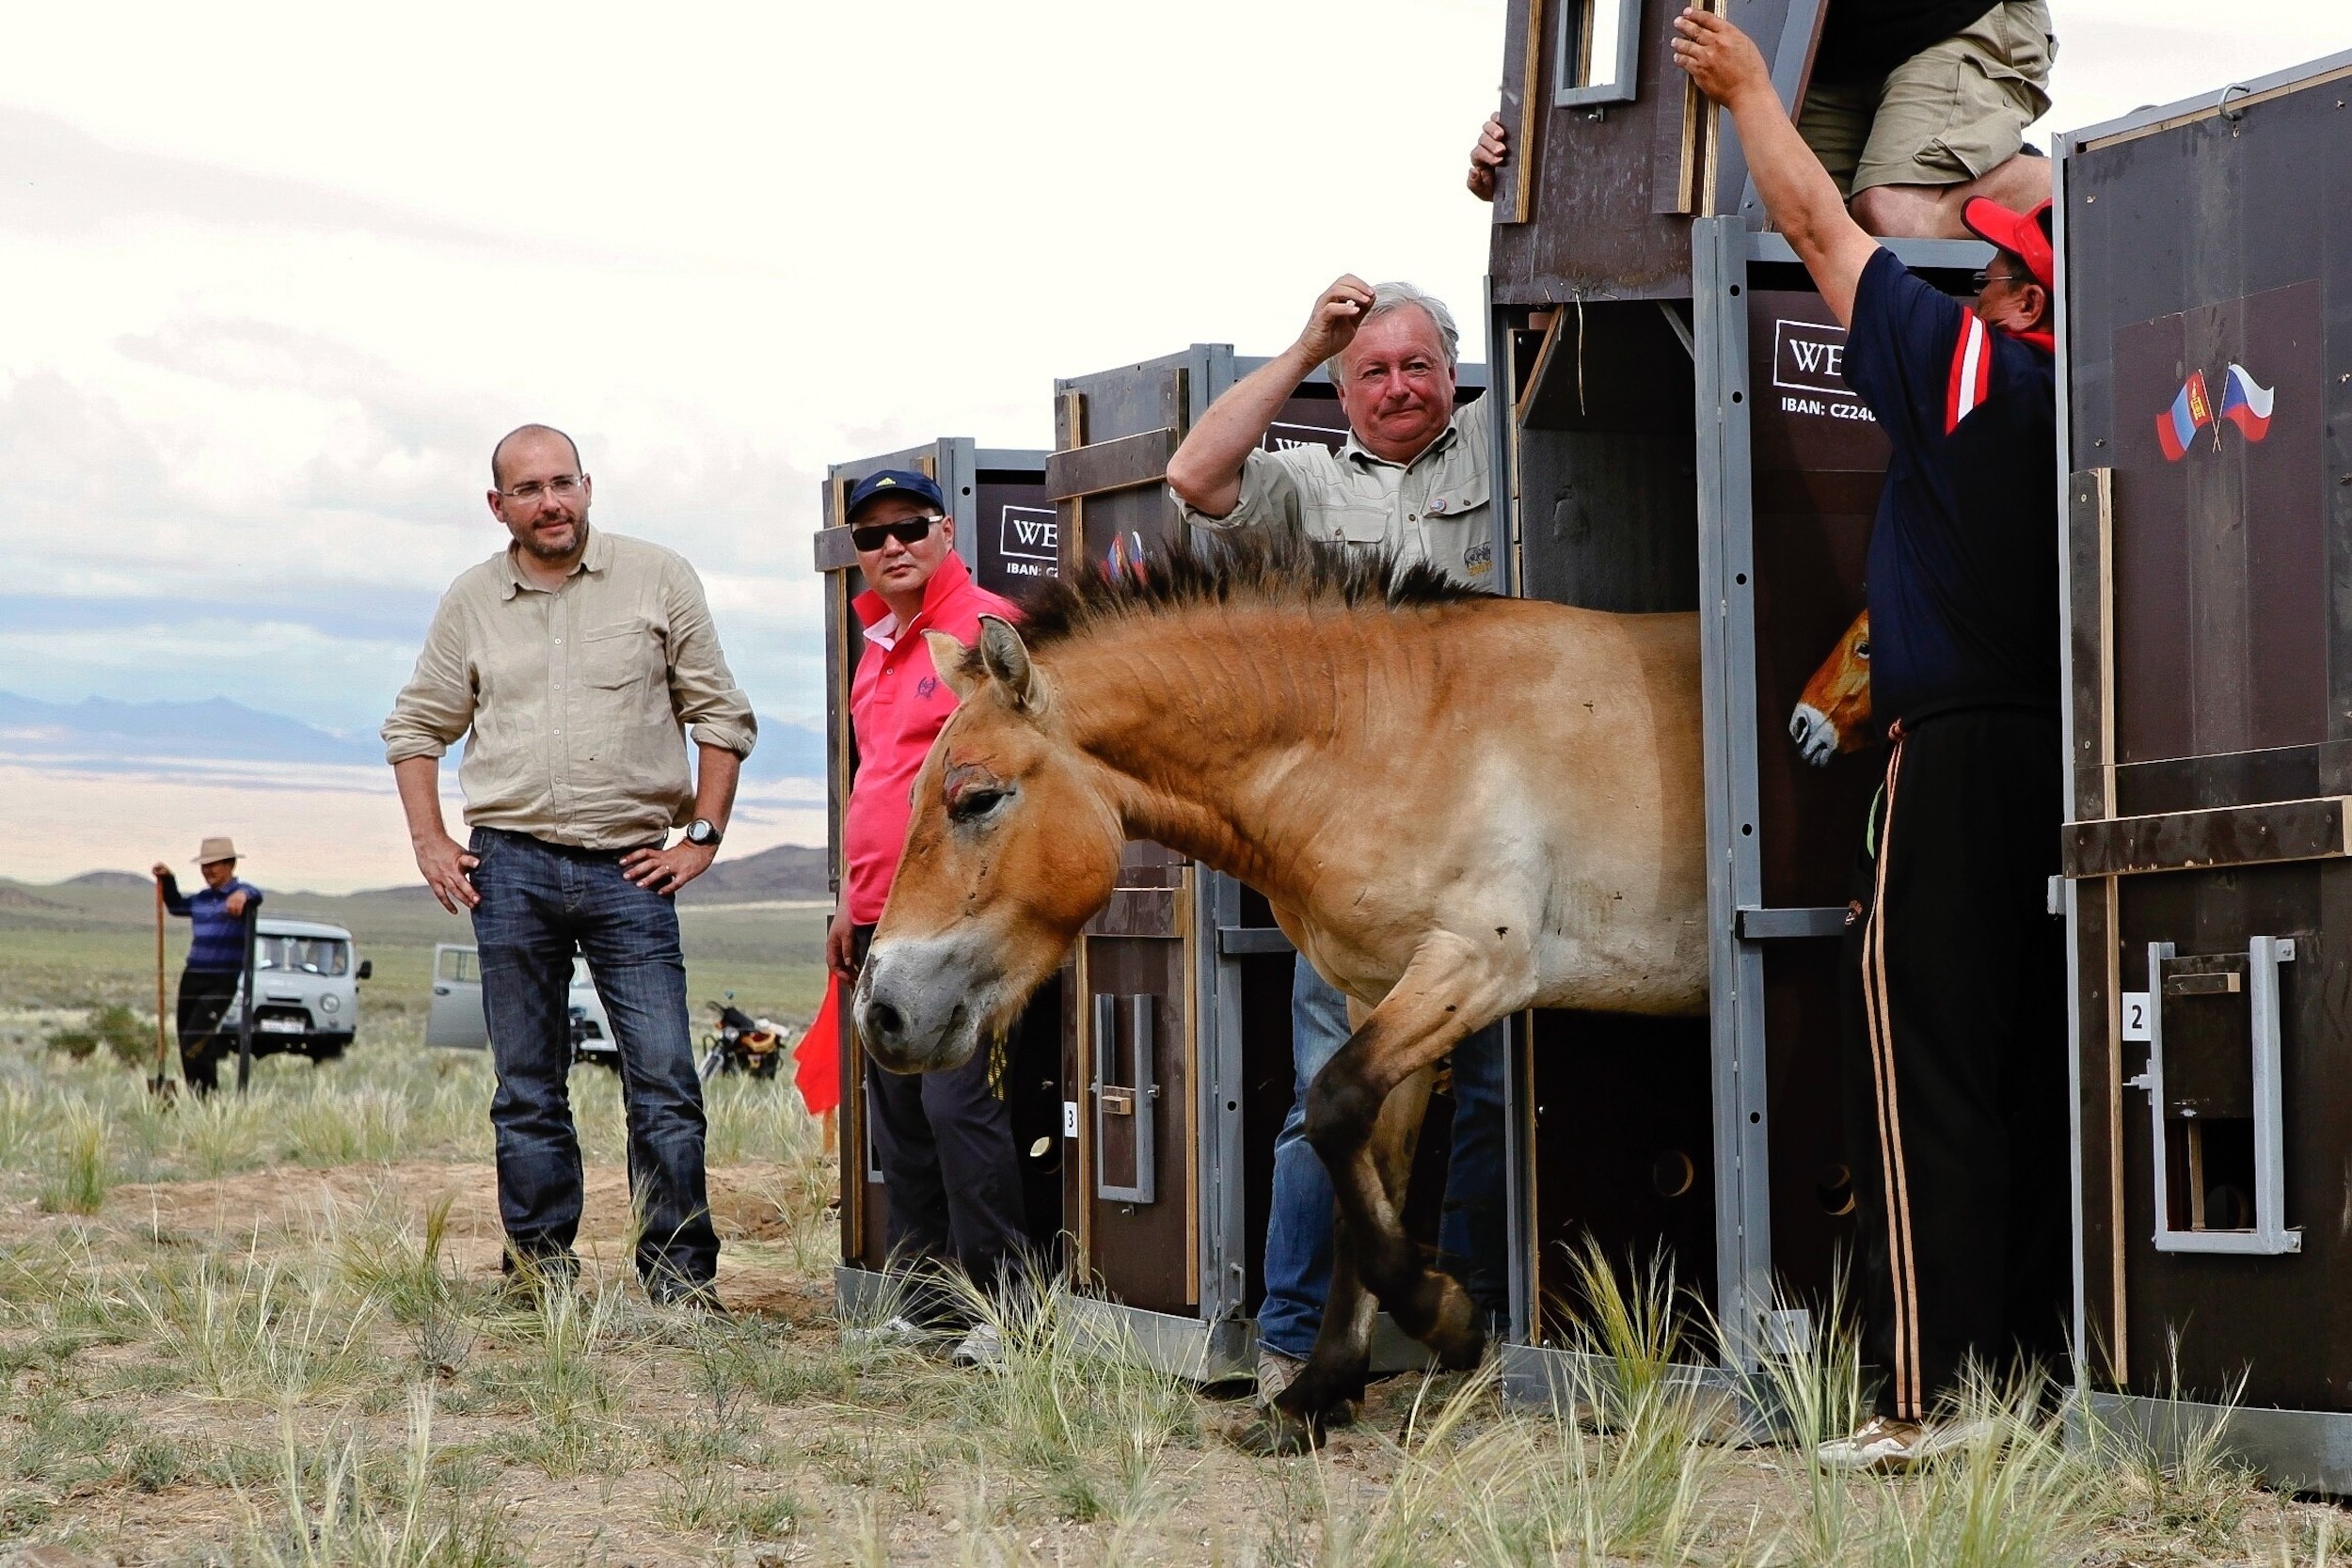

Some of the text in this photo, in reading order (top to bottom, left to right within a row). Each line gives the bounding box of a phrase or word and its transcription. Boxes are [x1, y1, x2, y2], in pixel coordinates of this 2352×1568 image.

[1789, 339, 1844, 376] WE
[1782, 397, 1825, 416] IBAN:
[1013, 519, 1057, 547] WE
[1007, 562, 1041, 577] IBAN:
[2132, 1005, 2142, 1029] 2
[1069, 1110, 1073, 1128] 3
